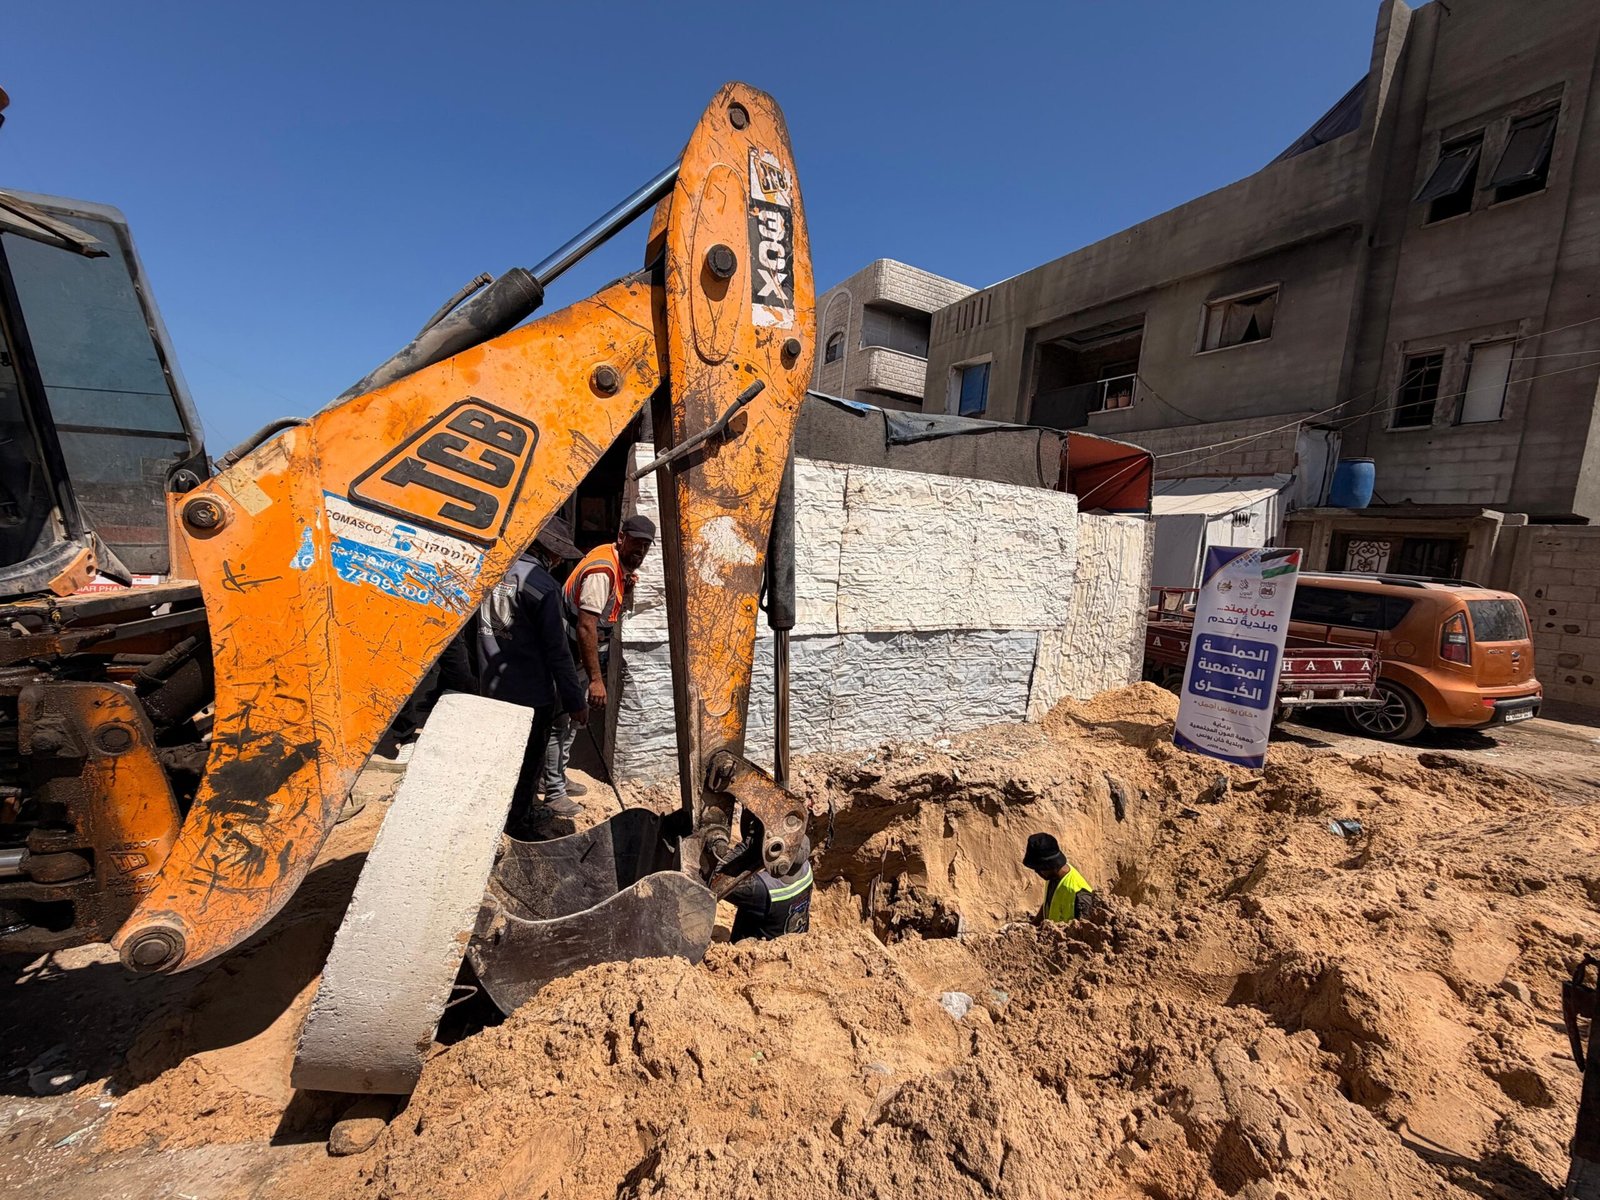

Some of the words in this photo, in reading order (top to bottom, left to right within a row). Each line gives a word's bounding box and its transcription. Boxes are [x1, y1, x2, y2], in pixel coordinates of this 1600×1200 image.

[761, 161, 786, 192] JCB
[757, 209, 788, 300] 3CX
[381, 409, 528, 530] JCB
[325, 508, 383, 534] COMASCO
[1207, 615, 1238, 625] تخدم
[1198, 657, 1266, 681] المجتمعية
